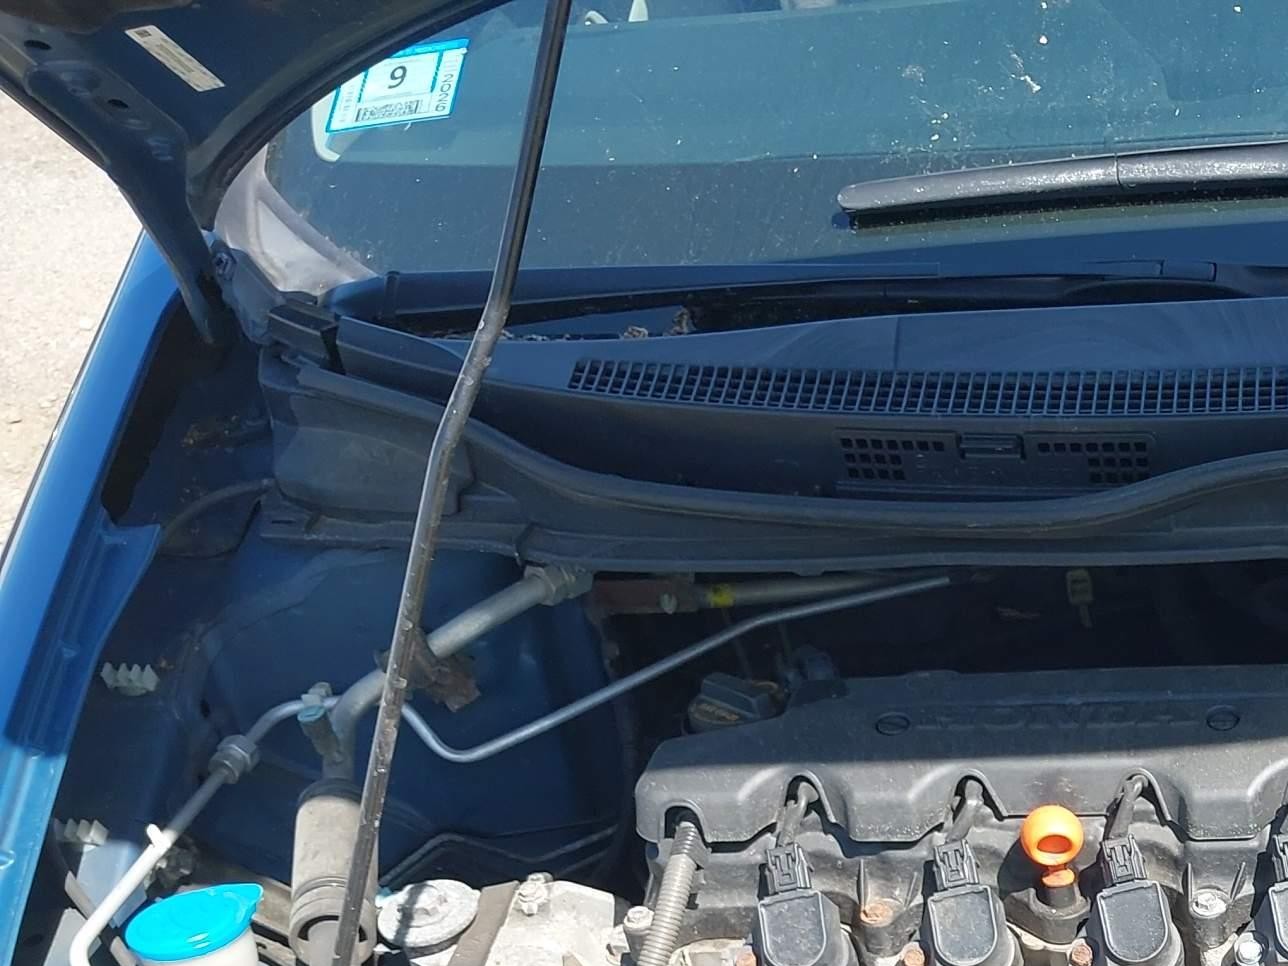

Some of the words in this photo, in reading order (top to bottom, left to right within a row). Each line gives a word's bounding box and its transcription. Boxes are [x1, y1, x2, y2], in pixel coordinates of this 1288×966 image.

[387, 65, 408, 89] 9
[435, 73, 454, 112] 2026
[916, 703, 1199, 731] HONDA
